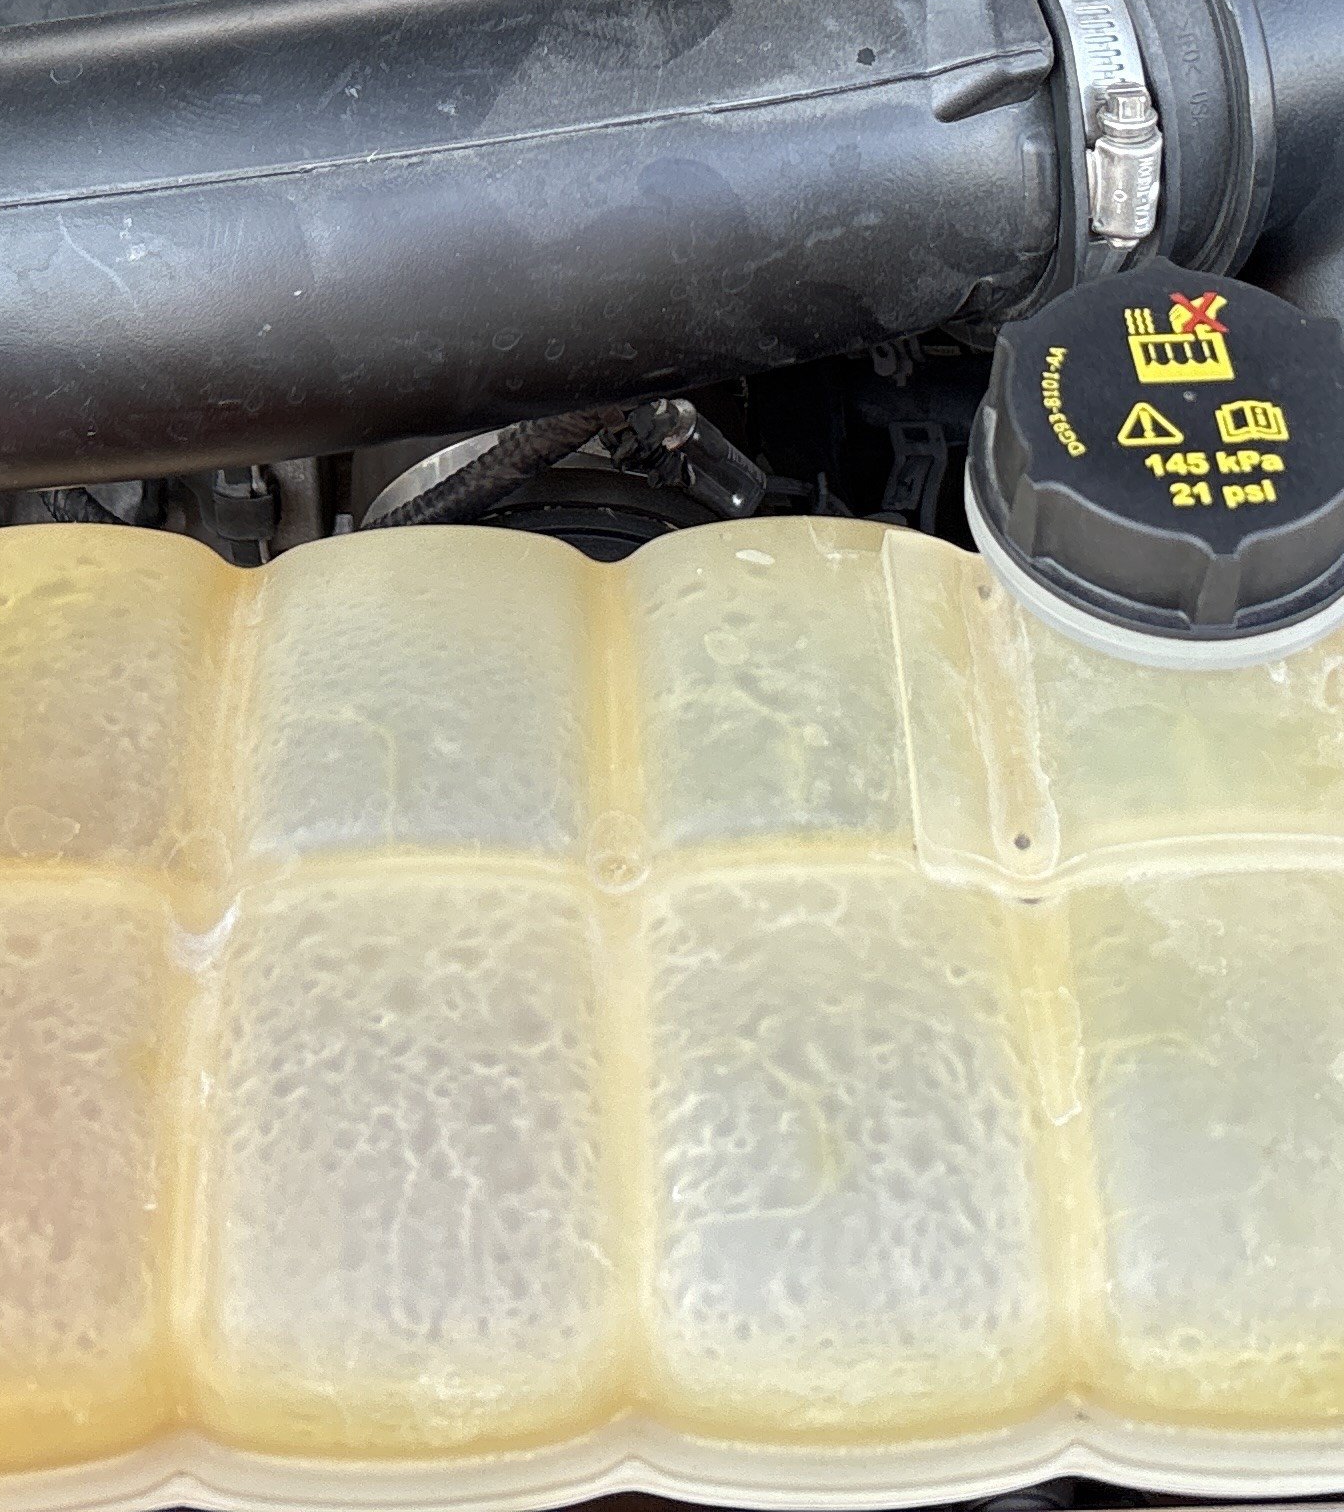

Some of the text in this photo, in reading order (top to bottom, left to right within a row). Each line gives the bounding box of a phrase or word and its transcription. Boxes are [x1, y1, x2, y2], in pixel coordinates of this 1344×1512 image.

[1144, 449, 1285, 478] 145 kPa
[1169, 478, 1277, 508] 21 psi
